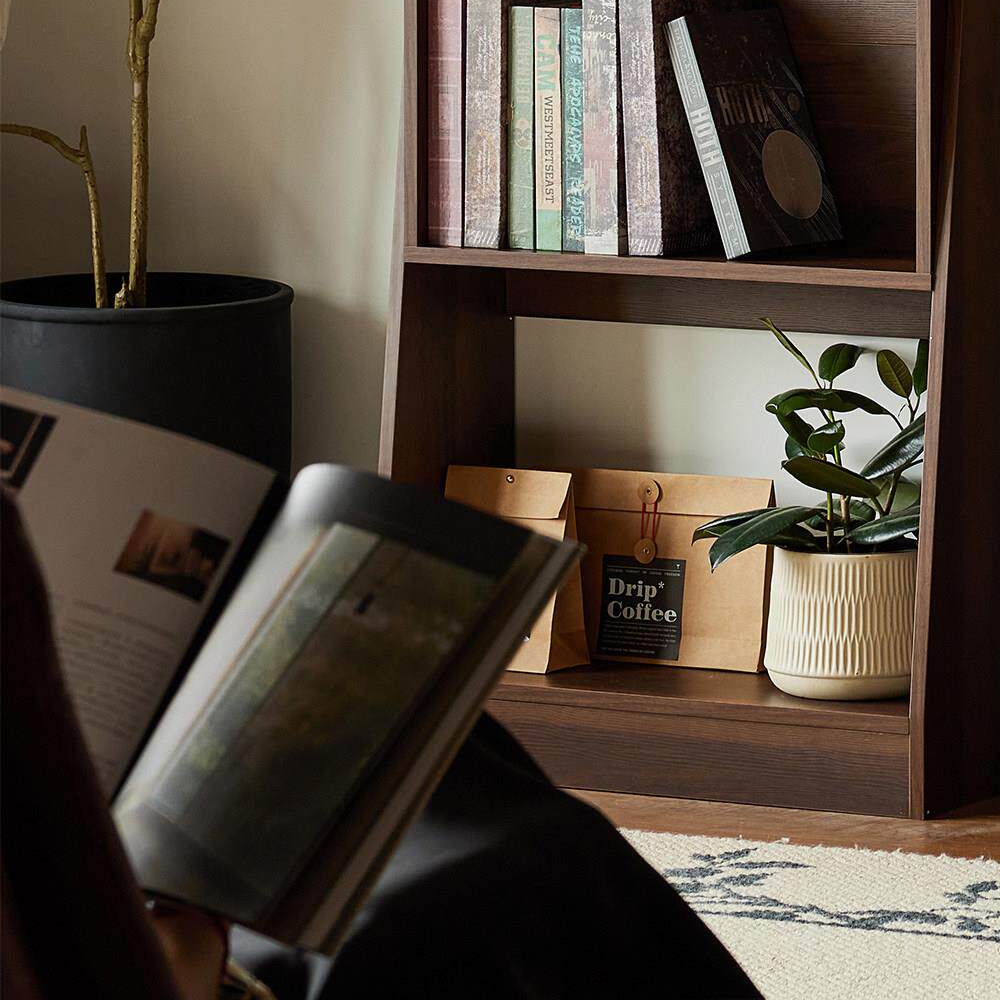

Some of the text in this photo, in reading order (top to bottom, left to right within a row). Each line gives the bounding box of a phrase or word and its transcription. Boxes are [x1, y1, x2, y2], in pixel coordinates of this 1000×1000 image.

[543, 94, 555, 204] WESTMEETSEAST
[690, 106, 722, 168] HOTH
[711, 171, 740, 249] SYSTEM
[607, 600, 678, 623] Coffee
[608, 577, 658, 602] Drip
